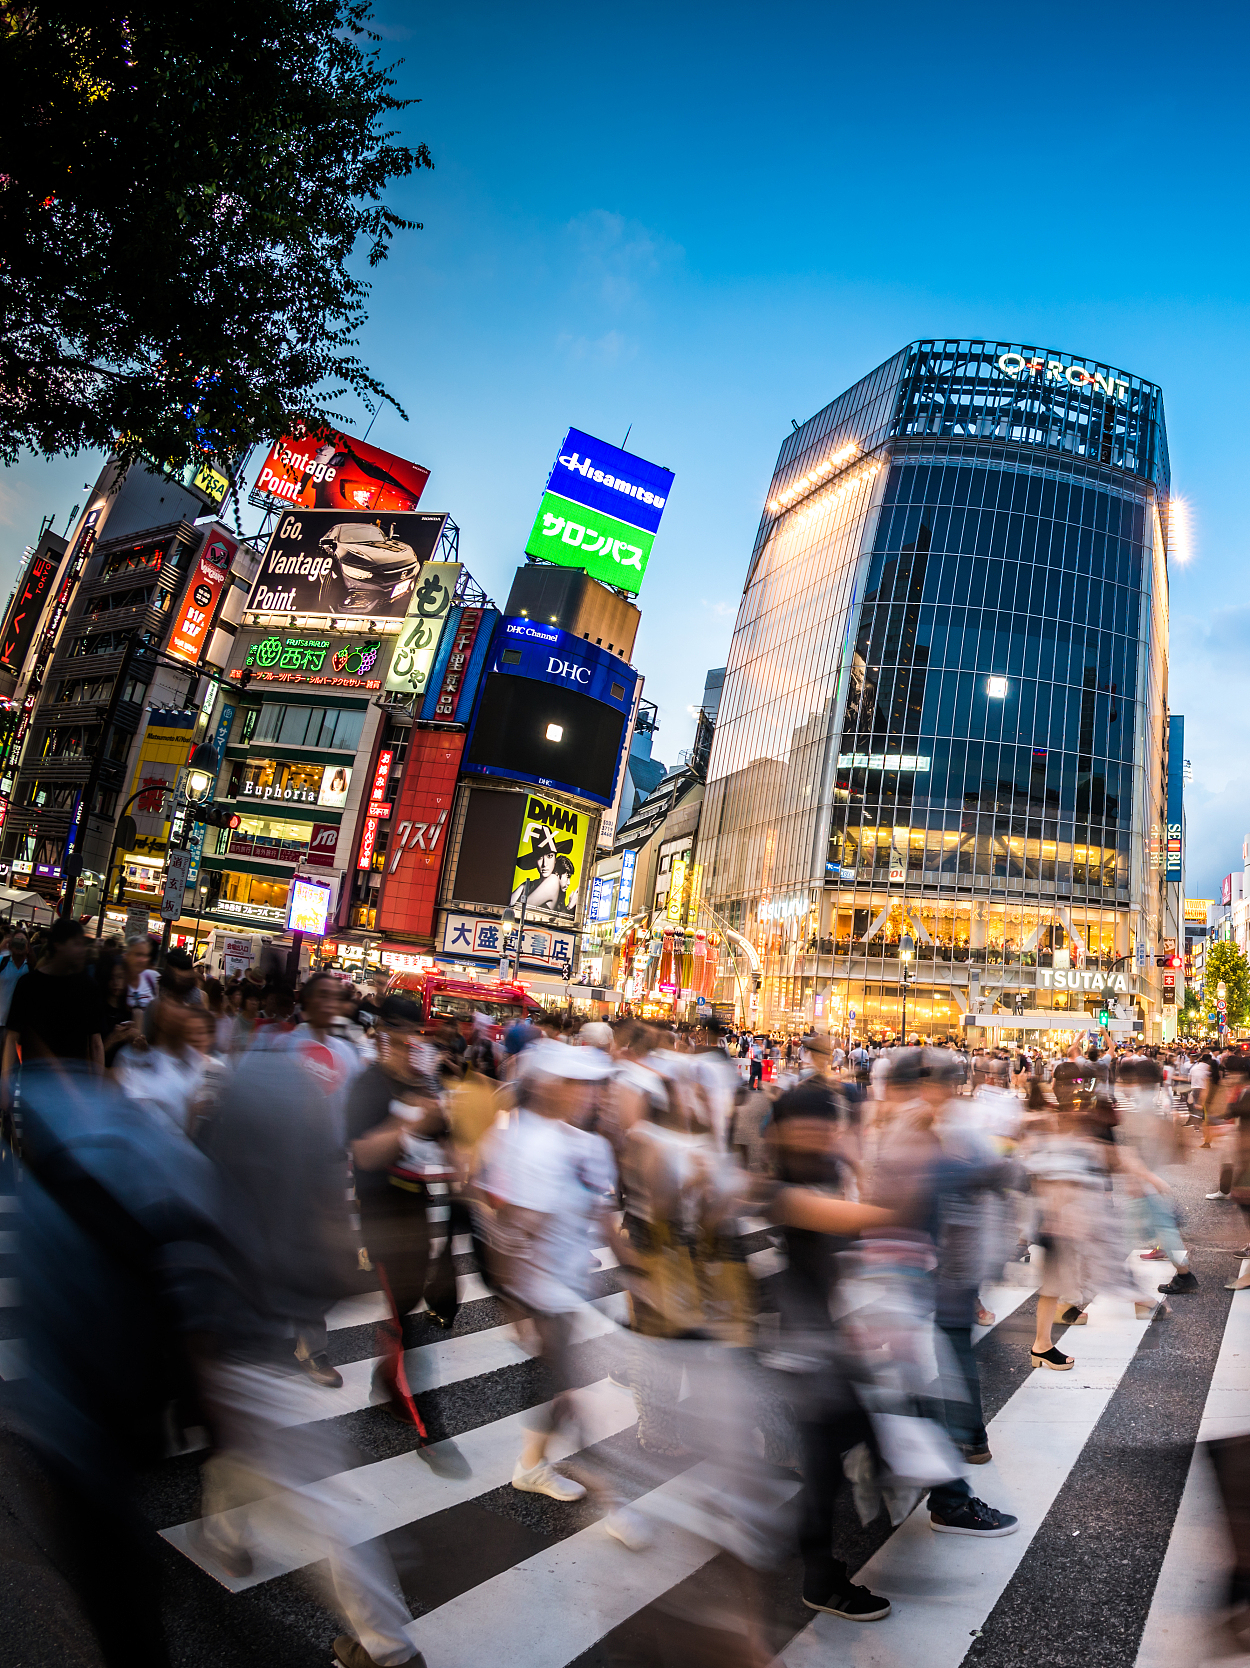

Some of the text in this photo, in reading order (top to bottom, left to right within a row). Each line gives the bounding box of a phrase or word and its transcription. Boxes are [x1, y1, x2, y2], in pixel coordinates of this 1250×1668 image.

[257, 467, 303, 503] Point.
[558, 452, 666, 509] Hisamitsu
[279, 515, 304, 541] Go,
[542, 512, 643, 571] サロンパス
[36, 563, 52, 594] TOKYO
[268, 550, 334, 582] Vantage
[251, 585, 297, 611] Point.
[393, 574, 450, 690] もんじゃ
[507, 624, 559, 643] DHC Channel
[436, 611, 478, 714] 三千里薬品
[546, 656, 592, 685] DHC
[243, 781, 316, 802] Euphoria
[538, 777, 553, 787] DHC
[527, 798, 578, 836] DMM
[312, 829, 337, 847] JTB
[388, 809, 448, 875] クスリ
[523, 822, 558, 852] FX
[1167, 823, 1181, 870] SEIBU
[166, 856, 183, 912] 道玄坂
[1041, 970, 1127, 991] TSUTAYA
